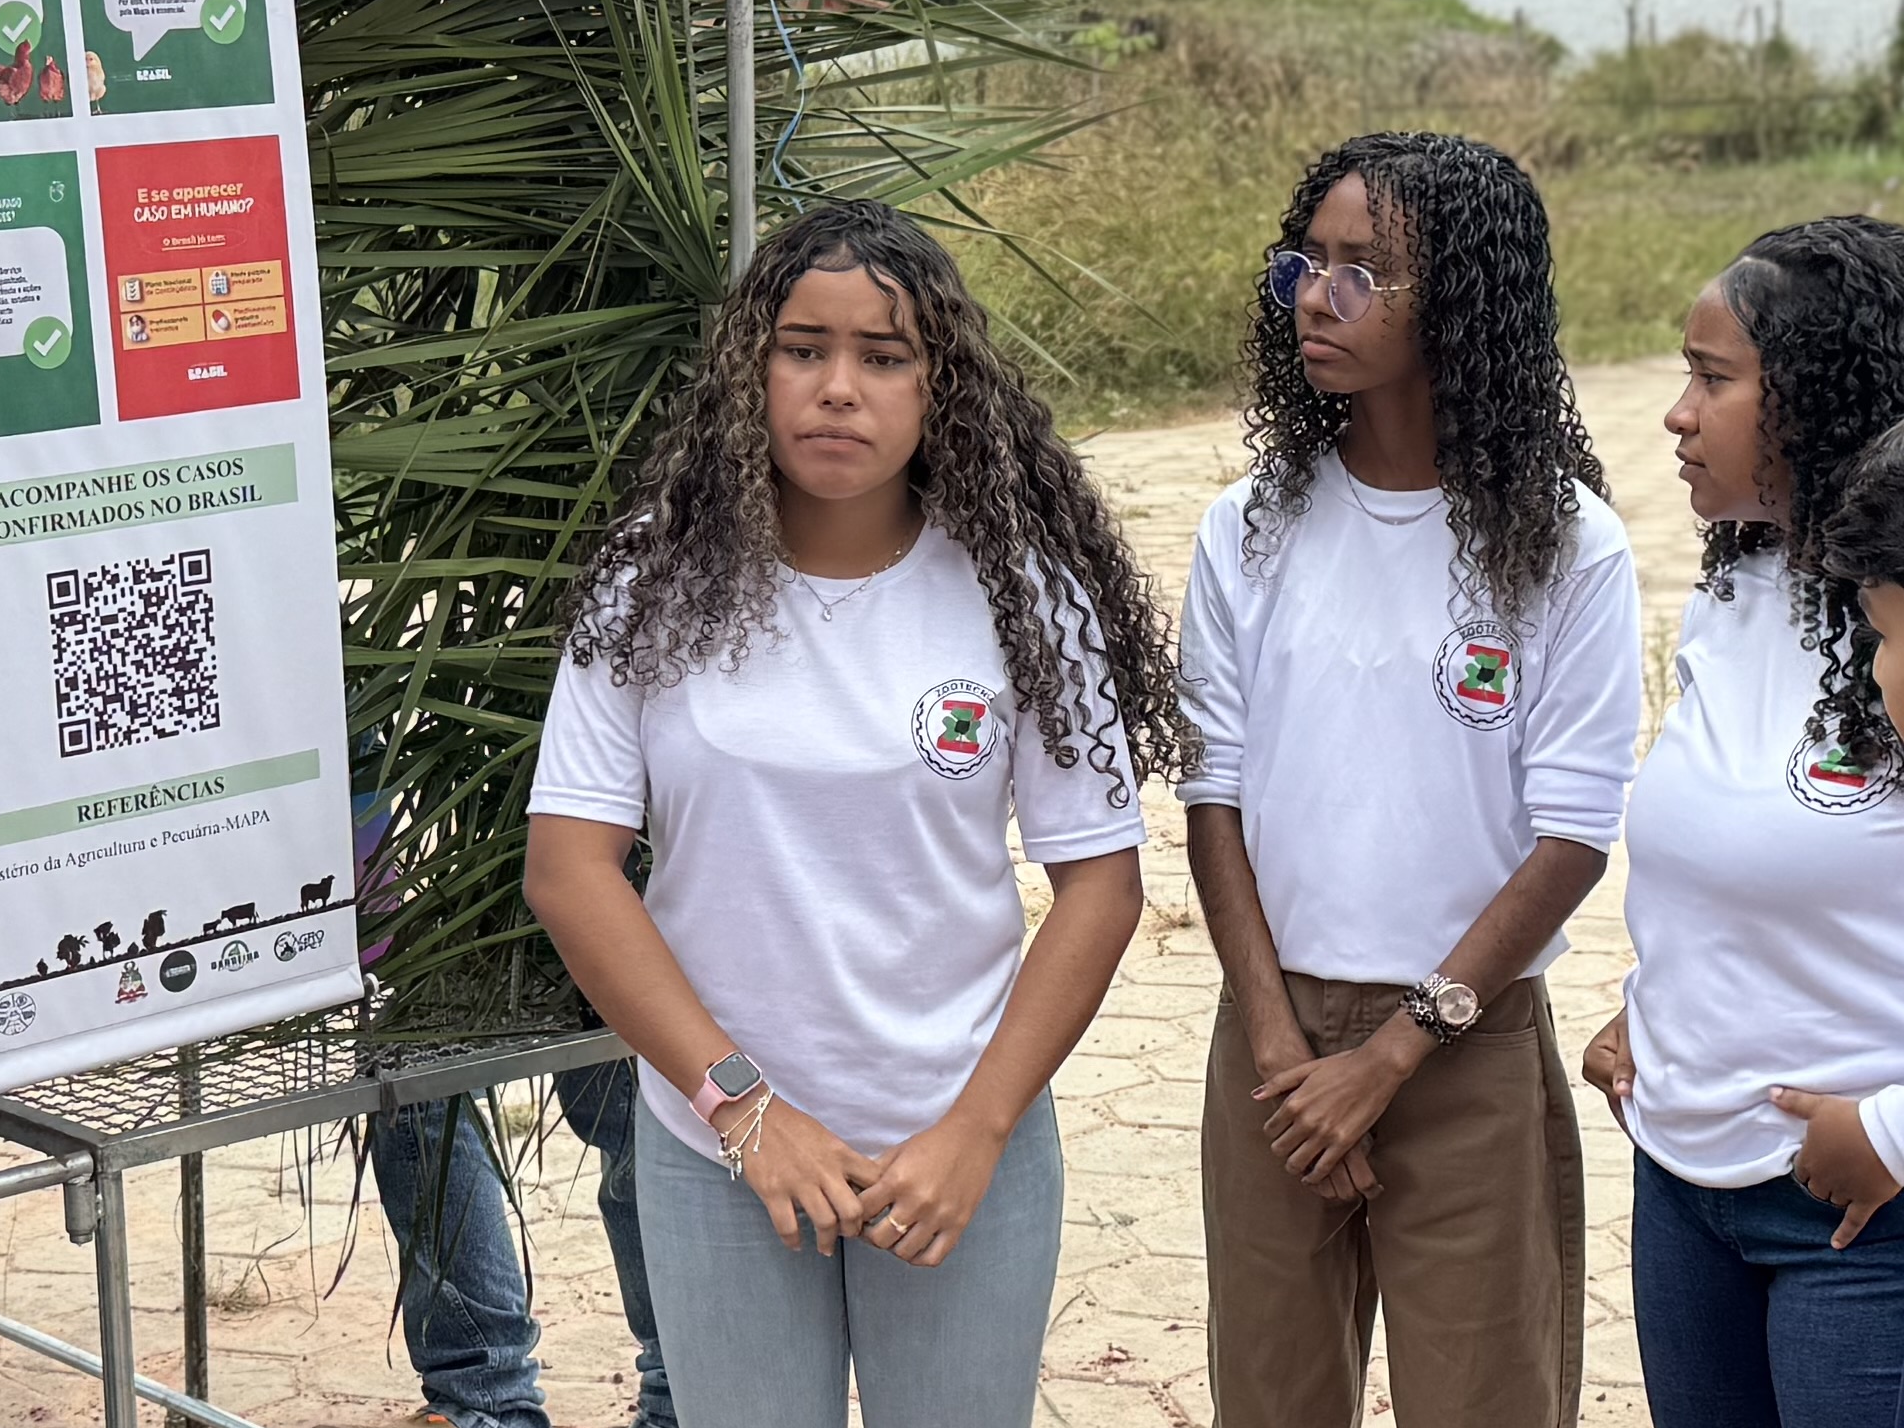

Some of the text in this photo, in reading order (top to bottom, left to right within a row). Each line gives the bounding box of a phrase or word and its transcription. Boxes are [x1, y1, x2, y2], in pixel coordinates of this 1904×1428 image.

[137, 183, 243, 203] E se aparecer
[134, 198, 254, 222] CASO EM HUMANO?
[143, 468, 170, 488] OS
[176, 457, 245, 484] CASOS
[151, 495, 182, 516] NO
[188, 484, 262, 511] BRASIL
[77, 776, 226, 823] REFERÊNCIAS
[44, 856, 61, 871] da
[65, 838, 146, 870] Agricultura
[161, 808, 271, 846] Pecuária-MAPA
